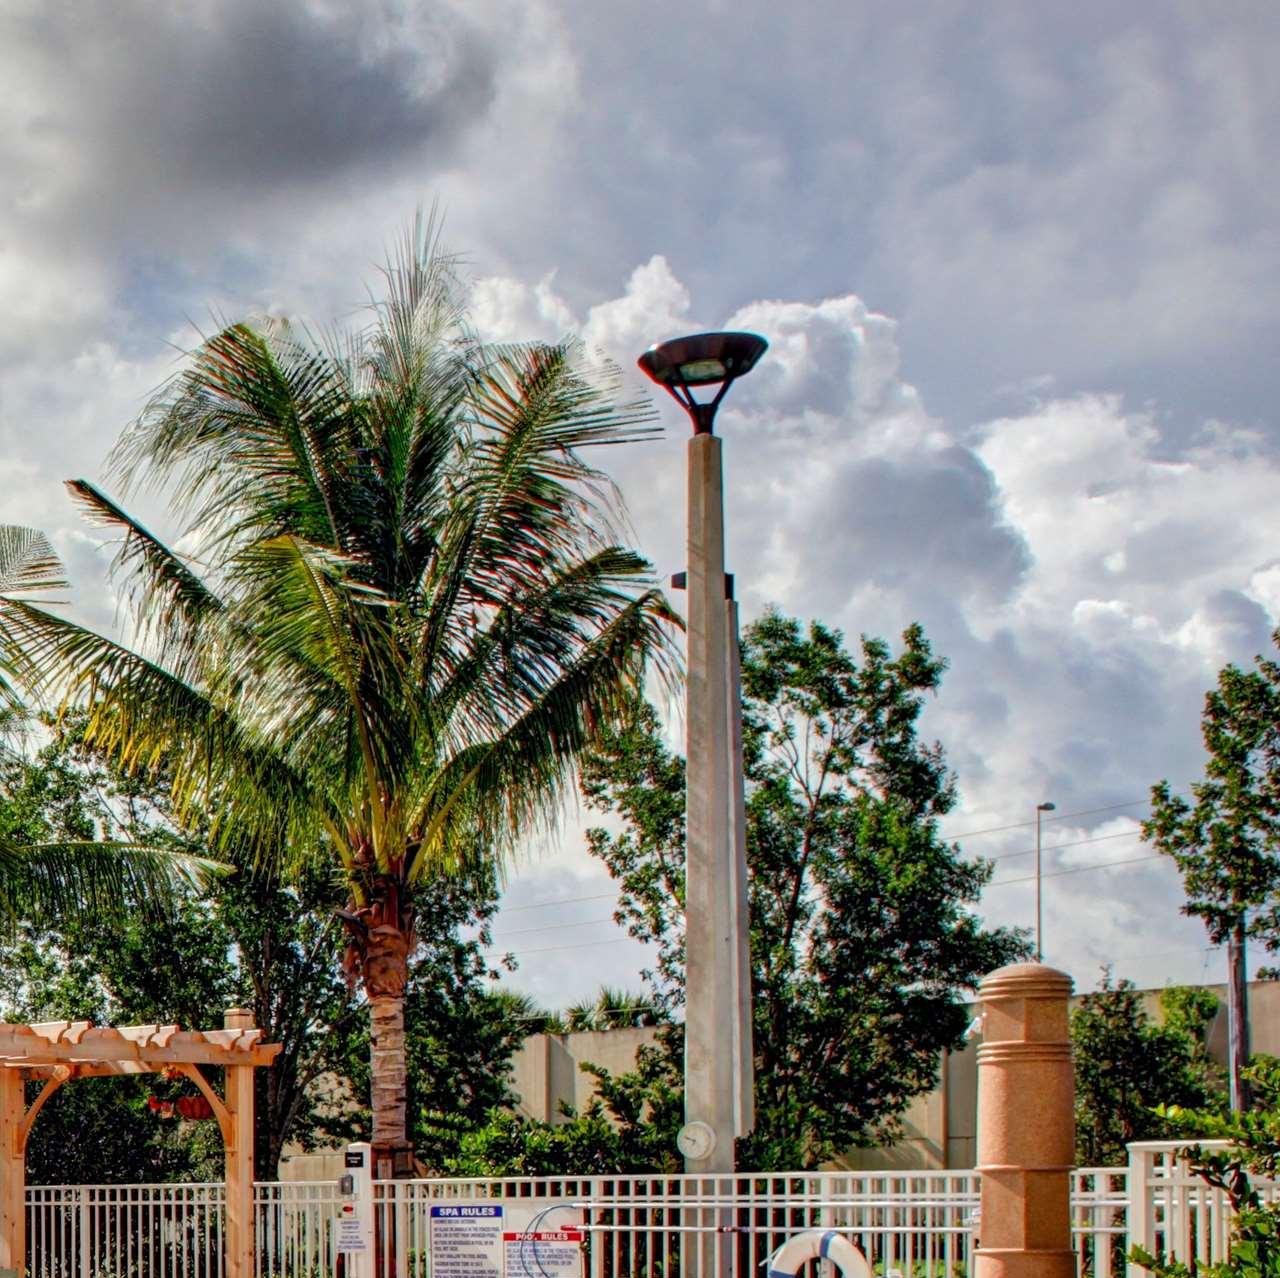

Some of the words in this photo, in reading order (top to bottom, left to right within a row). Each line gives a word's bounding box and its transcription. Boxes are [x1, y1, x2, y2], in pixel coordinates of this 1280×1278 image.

[439, 1207, 459, 1216] SPA
[461, 1207, 495, 1216] RULES
[541, 1233, 568, 1241] RULES
